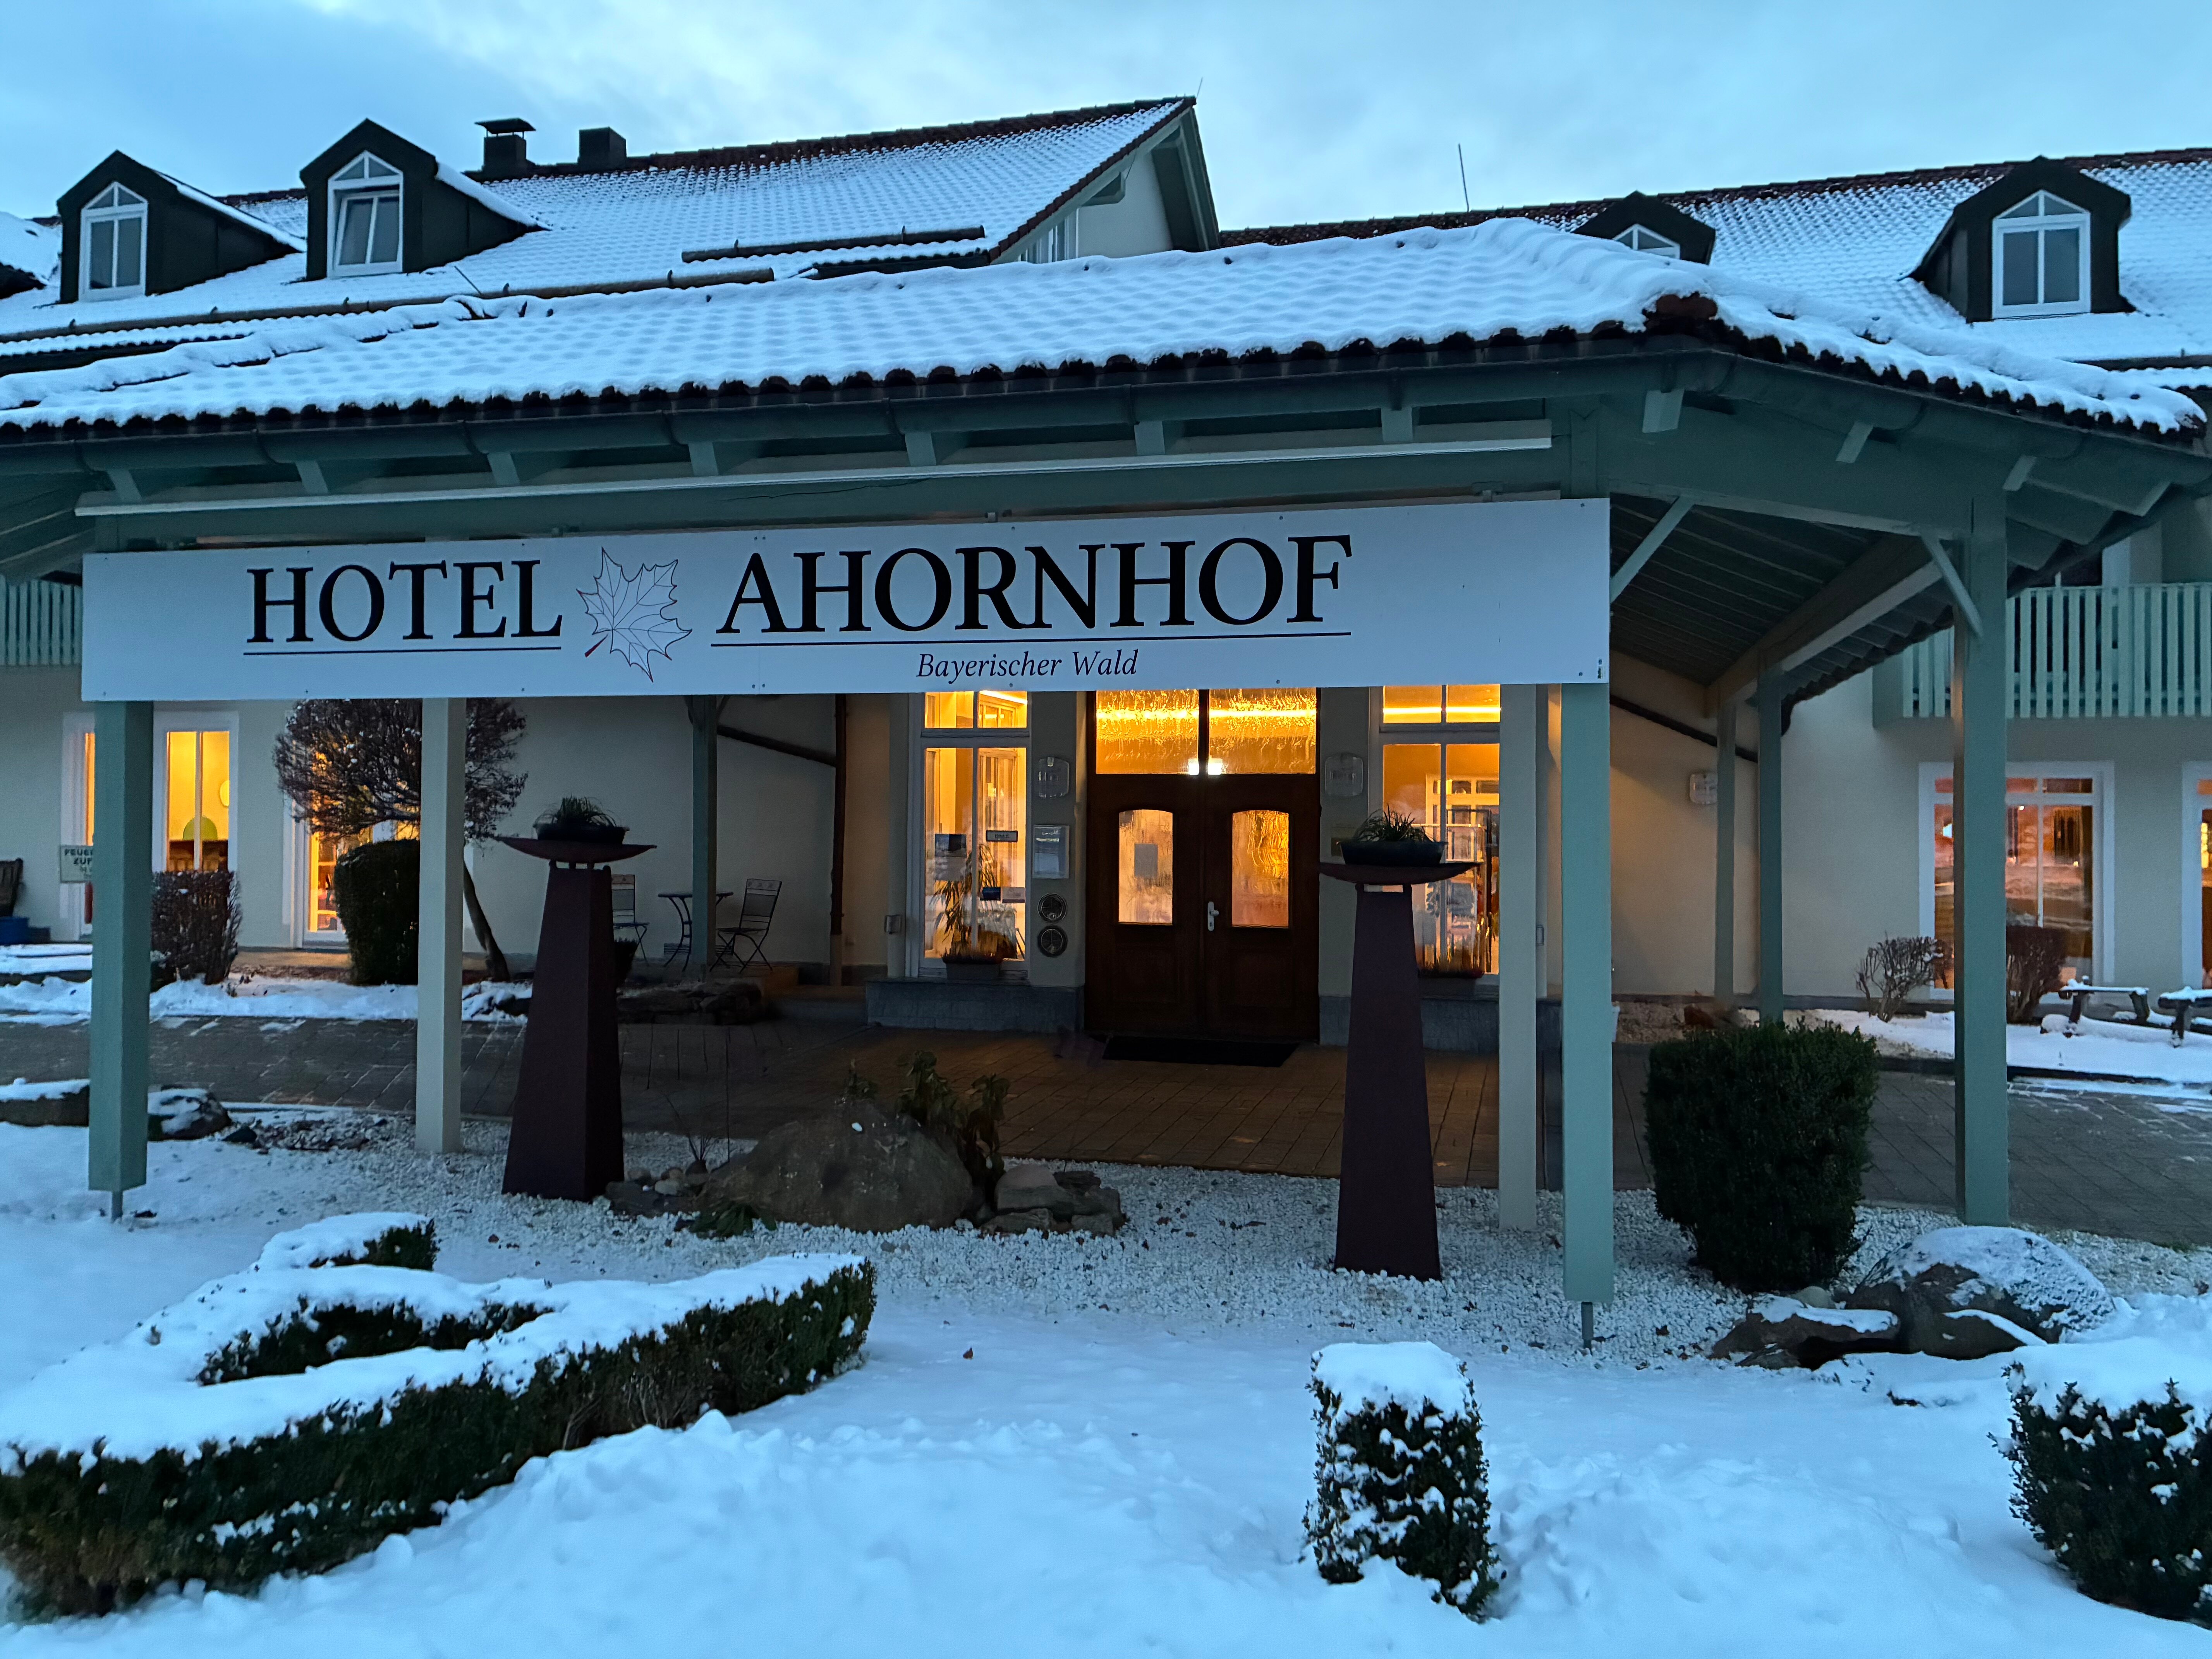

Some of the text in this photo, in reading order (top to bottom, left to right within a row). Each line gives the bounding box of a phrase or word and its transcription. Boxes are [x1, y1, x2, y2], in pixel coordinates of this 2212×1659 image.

[246, 534, 1353, 643] HOTEL AHORNHOF
[916, 649, 1139, 684] Bayerischer Wald
